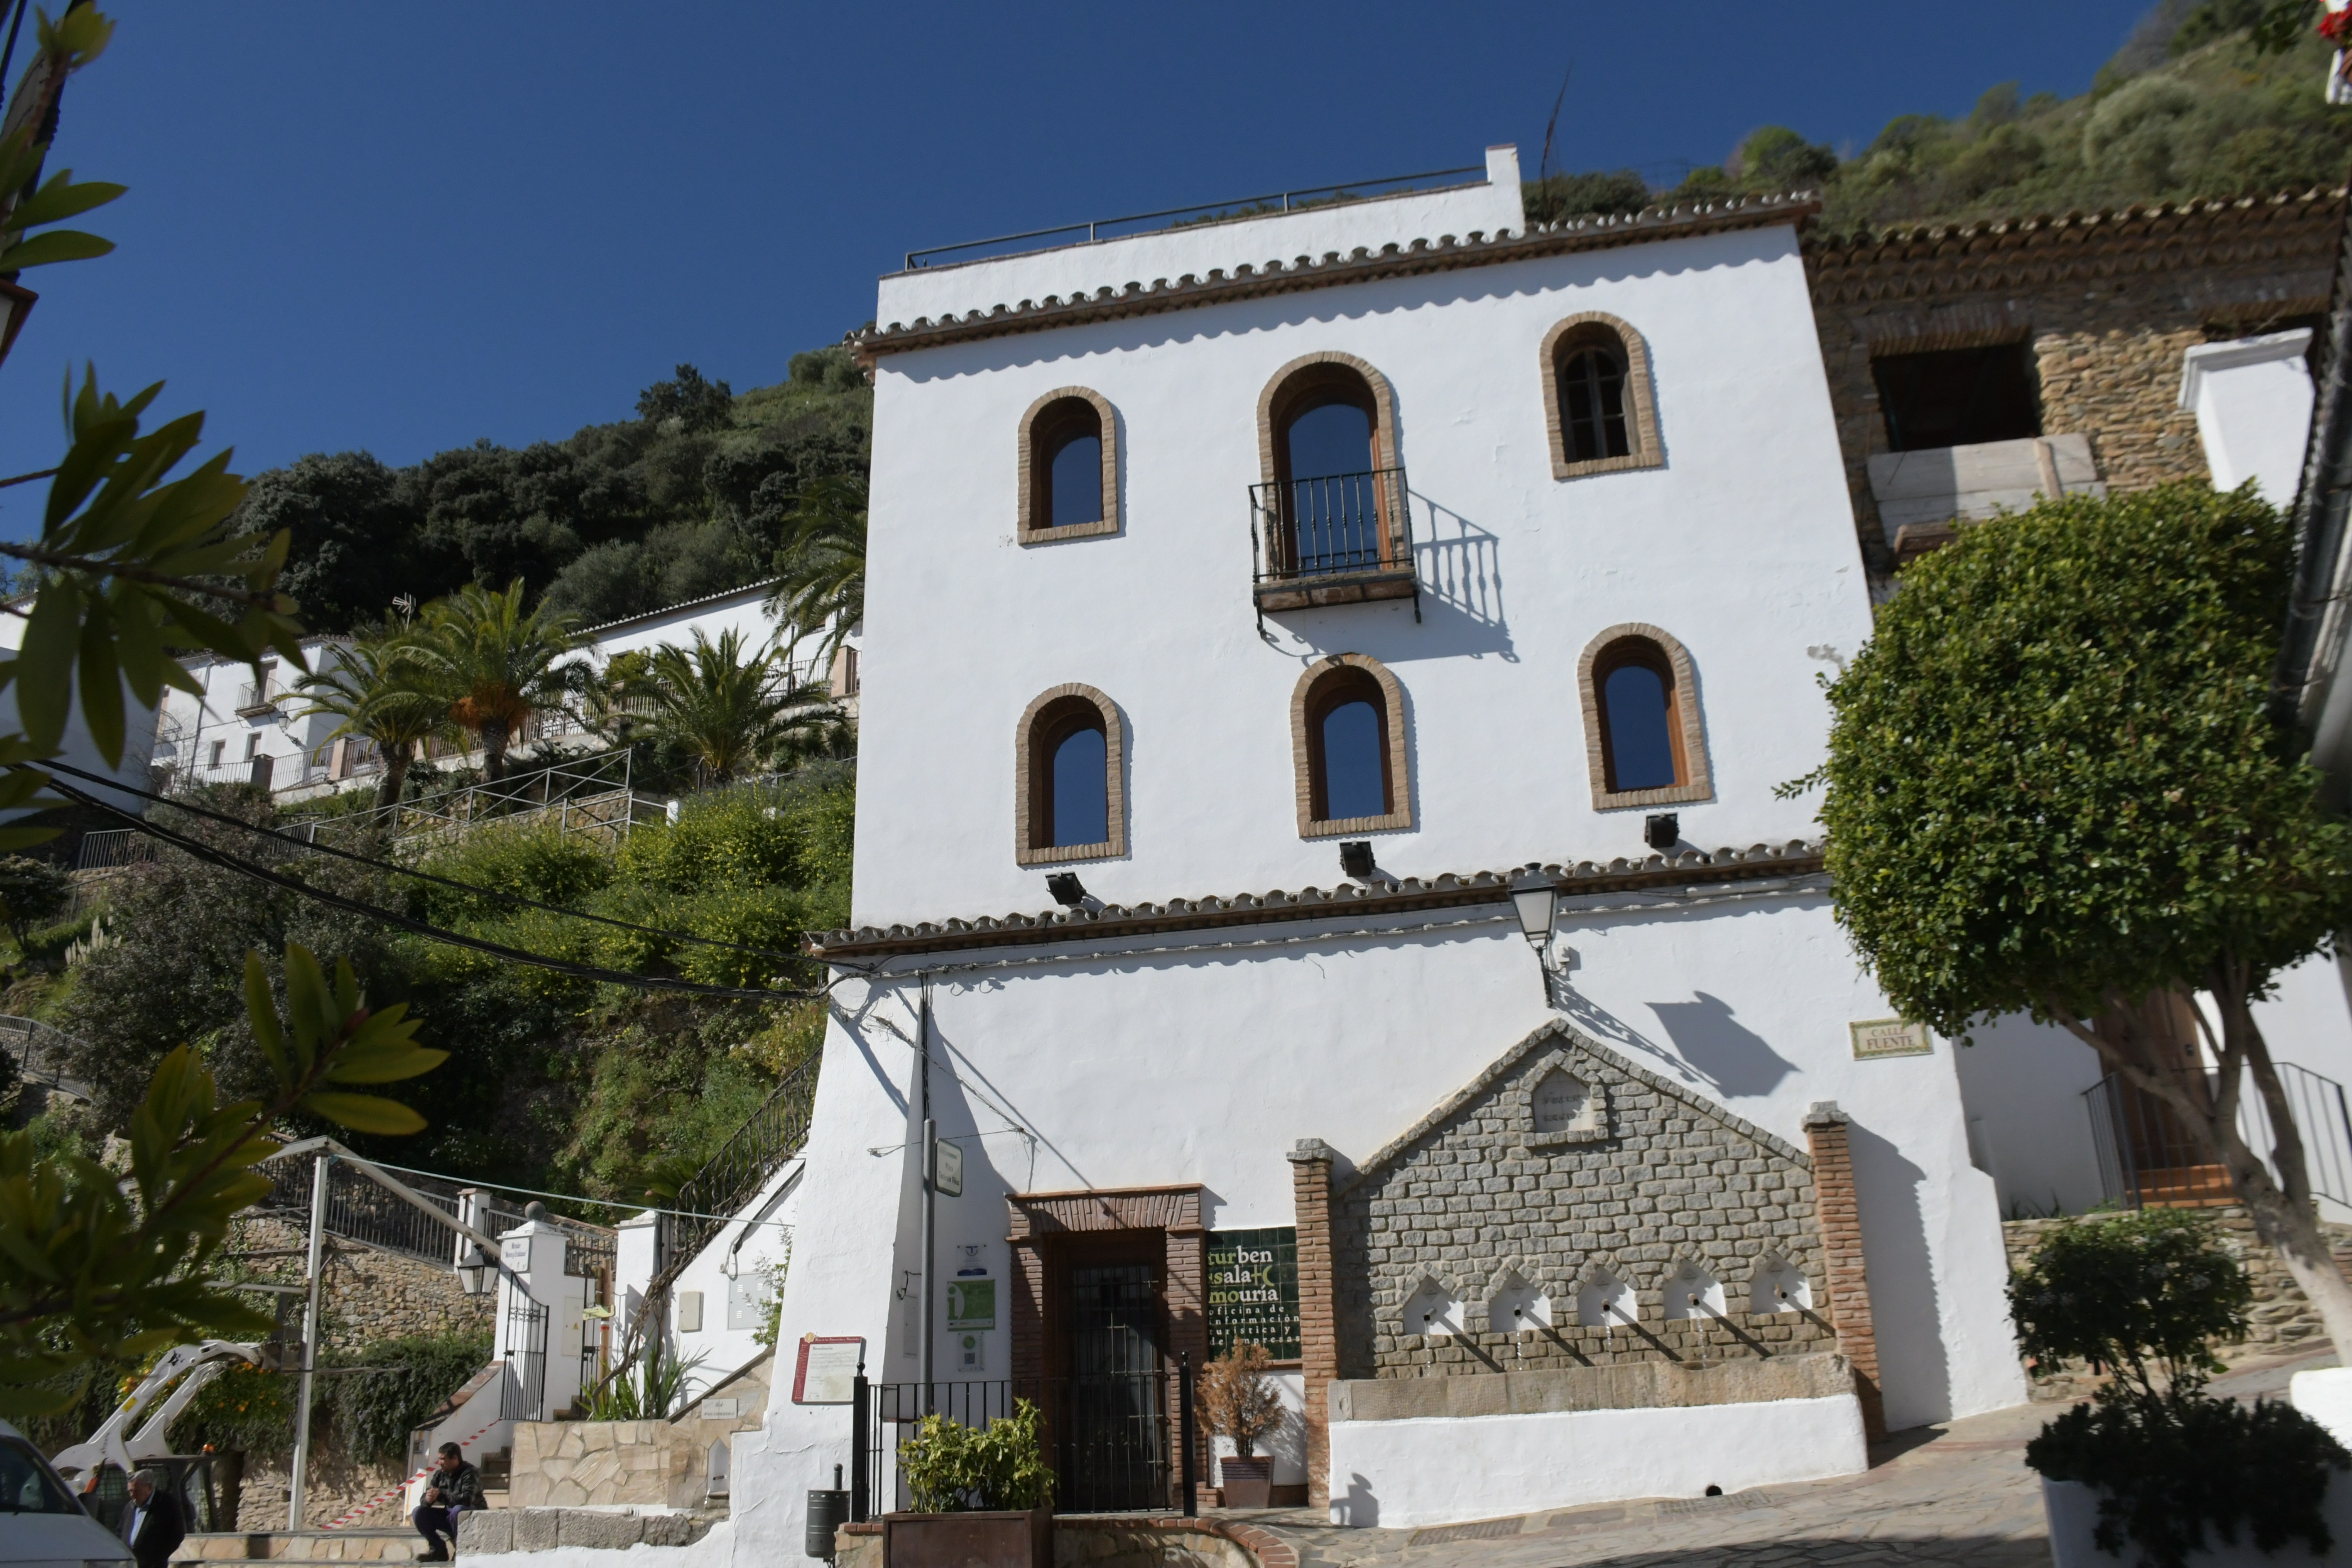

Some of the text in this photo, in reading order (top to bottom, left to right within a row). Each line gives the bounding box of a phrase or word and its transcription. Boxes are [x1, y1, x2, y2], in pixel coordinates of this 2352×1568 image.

[1867, 1036, 1915, 1049] FUENTE
[1208, 1245, 1273, 1266] turben
[1209, 1304, 1284, 1315] oficina de
[1209, 1314, 1299, 1325] información
[1284, 1326, 1290, 1335] y
[1209, 1337, 1224, 1346] de
